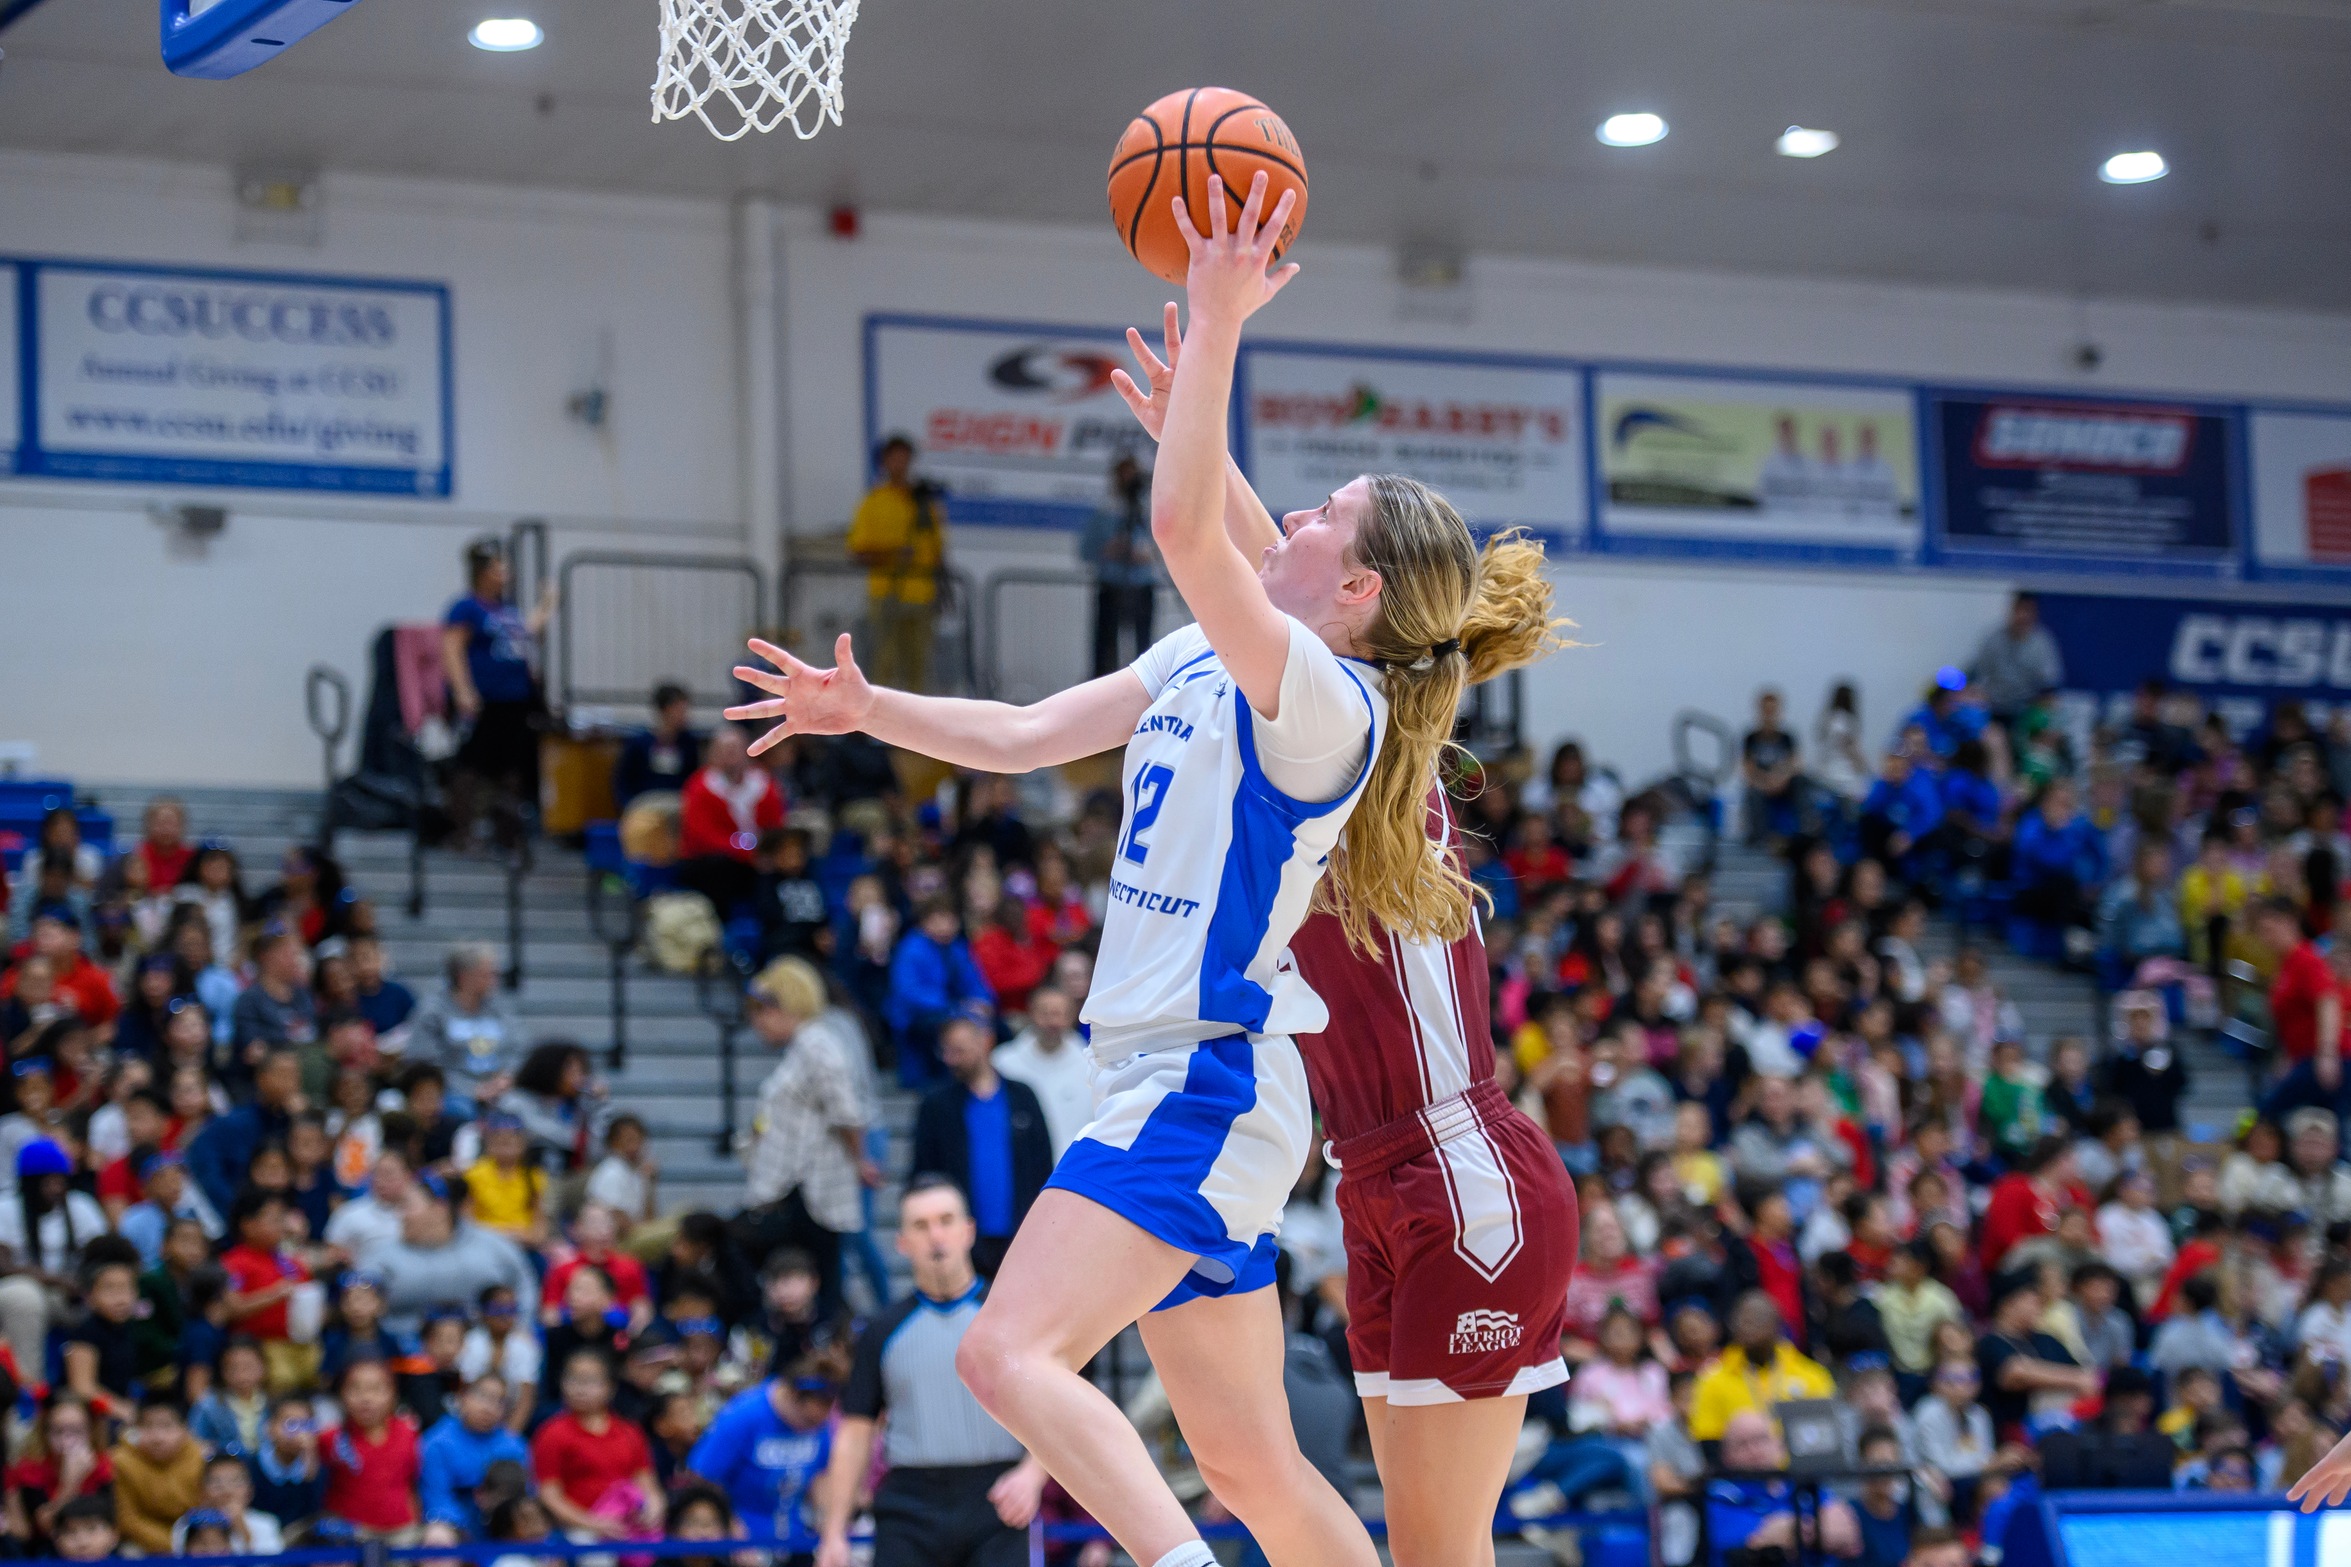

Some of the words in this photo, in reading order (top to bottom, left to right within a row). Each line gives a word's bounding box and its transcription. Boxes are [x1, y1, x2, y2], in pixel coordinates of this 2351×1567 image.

[88, 283, 396, 346] CCSUCCESS
[79, 351, 178, 383] Annual
[925, 408, 1063, 454] SIGN
[1117, 758, 1177, 869] 12
[1448, 1336, 1520, 1354] LEAGUE
[1449, 1325, 1524, 1344] PATRIOT
